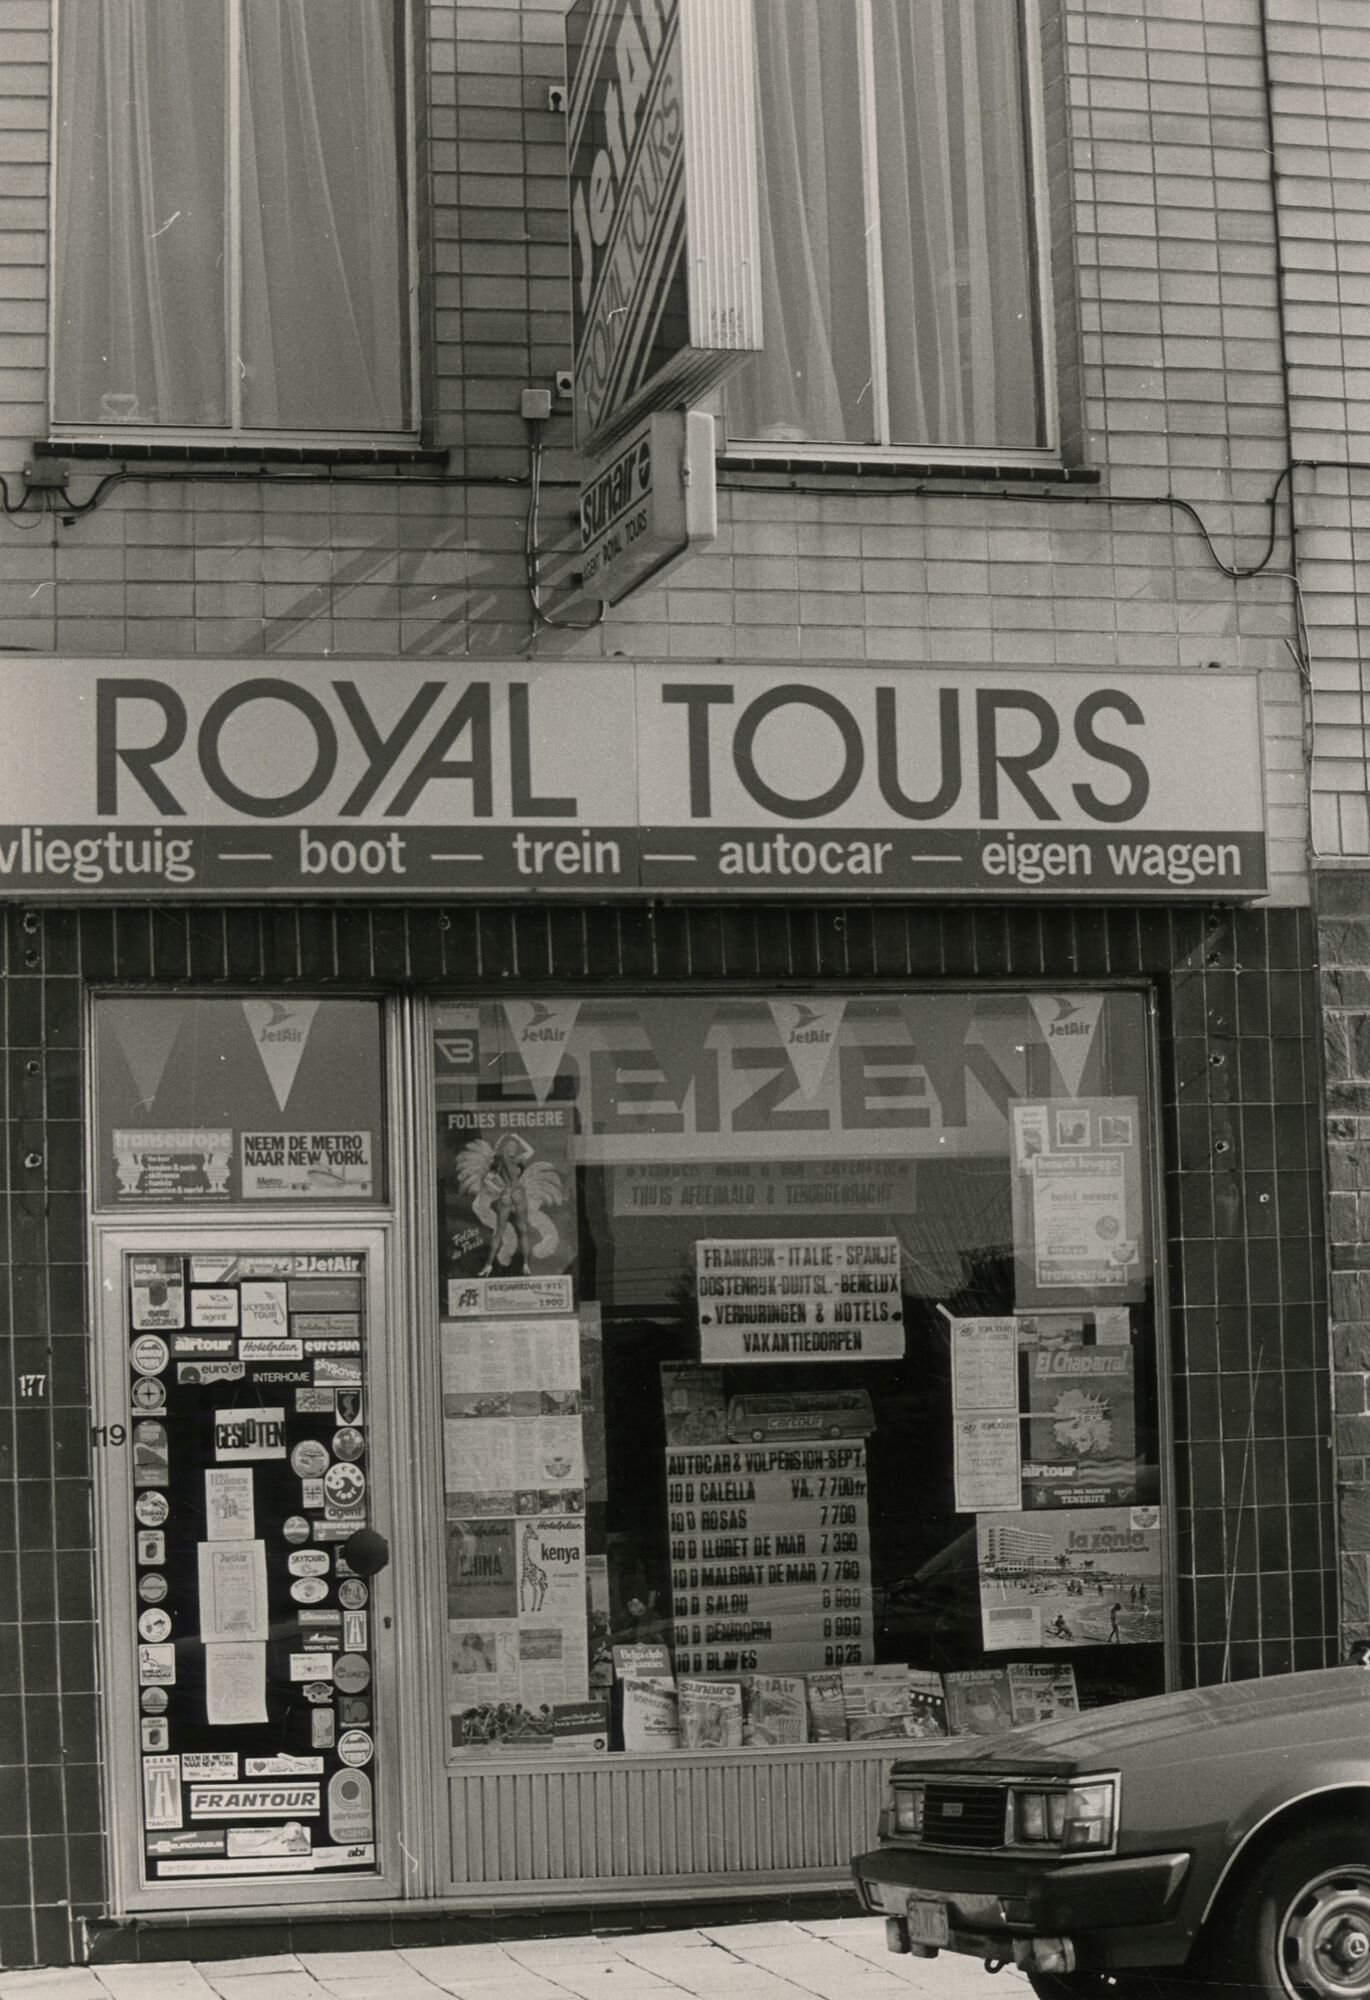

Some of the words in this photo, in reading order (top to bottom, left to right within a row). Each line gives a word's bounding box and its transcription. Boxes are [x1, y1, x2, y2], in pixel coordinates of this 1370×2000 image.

[620, 72, 680, 280] TOURS
[582, 449, 637, 544] sunair
[96, 677, 578, 819] ROYAL
[661, 683, 1151, 823] TOURS
[0, 828, 196, 883] vliegtuig
[300, 829, 406, 875] boot
[512, 828, 621, 874] trein
[718, 833, 893, 876] autocar
[982, 832, 1092, 885] eigen
[1106, 843, 1241, 885] wagen
[259, 1028, 303, 1043] JetAir
[521, 1027, 566, 1043] JetAir
[788, 1029, 832, 1045] JetAir
[1049, 1022, 1091, 1038] JetAir
[448, 1113, 496, 1129] FOLIES
[500, 1110, 564, 1128] BERGERE
[114, 1131, 231, 1151] transeurope
[244, 1136, 285, 1150] NEEM
[289, 1136, 307, 1150] DE
[311, 1135, 363, 1150] METRO
[244, 1152, 285, 1166] NAAR
[288, 1151, 322, 1166] NEW
[326, 1150, 369, 1166] YORK.
[631, 1184, 673, 1206] THUIS
[308, 1256, 360, 1272] JetAir
[788, 1246, 833, 1267] ITALIE
[846, 1245, 898, 1266] SPANJE
[242, 1303, 277, 1312] ULYSSE
[253, 1311, 278, 1320] TOUR
[715, 1303, 807, 1326] VERHURINGEN
[815, 1302, 825, 1324] &
[834, 1301, 889, 1323] HOTELS
[242, 1340, 300, 1354] Hotelplan
[303, 1340, 361, 1353] eurosun
[743, 1331, 863, 1353] VAKANTIEDORPEN
[201, 1362, 244, 1375] euroet
[1035, 1352, 1050, 1374] El
[1053, 1349, 1127, 1374] Chaparral
[19, 1374, 47, 1397] 177
[252, 1372, 310, 1383] INTERHOME
[91, 1424, 127, 1447] 119
[216, 1418, 286, 1449] GESLOTEN
[700, 1480, 756, 1503] CALELLA
[328, 1506, 362, 1519] agent
[701, 1509, 748, 1531] ROSAS
[702, 1537, 749, 1559] LLORET
[753, 1536, 772, 1557] DE
[775, 1534, 807, 1556] MAR
[1069, 1530, 1089, 1549] la
[291, 1554, 327, 1565] SKYTOURS
[541, 1543, 581, 1565] kenya
[460, 1554, 503, 1577] CHINA
[701, 1564, 765, 1587] MALGRAT
[768, 1563, 784, 1584] DE
[785, 1562, 817, 1583] MAR
[705, 1593, 749, 1615] SALOU
[1010, 1665, 1072, 1678] skifrance
[680, 1682, 725, 1695] sunair
[748, 1675, 796, 1694] JetAir
[194, 1791, 316, 1808] FRANTOUR
[347, 1846, 366, 1858] abi
